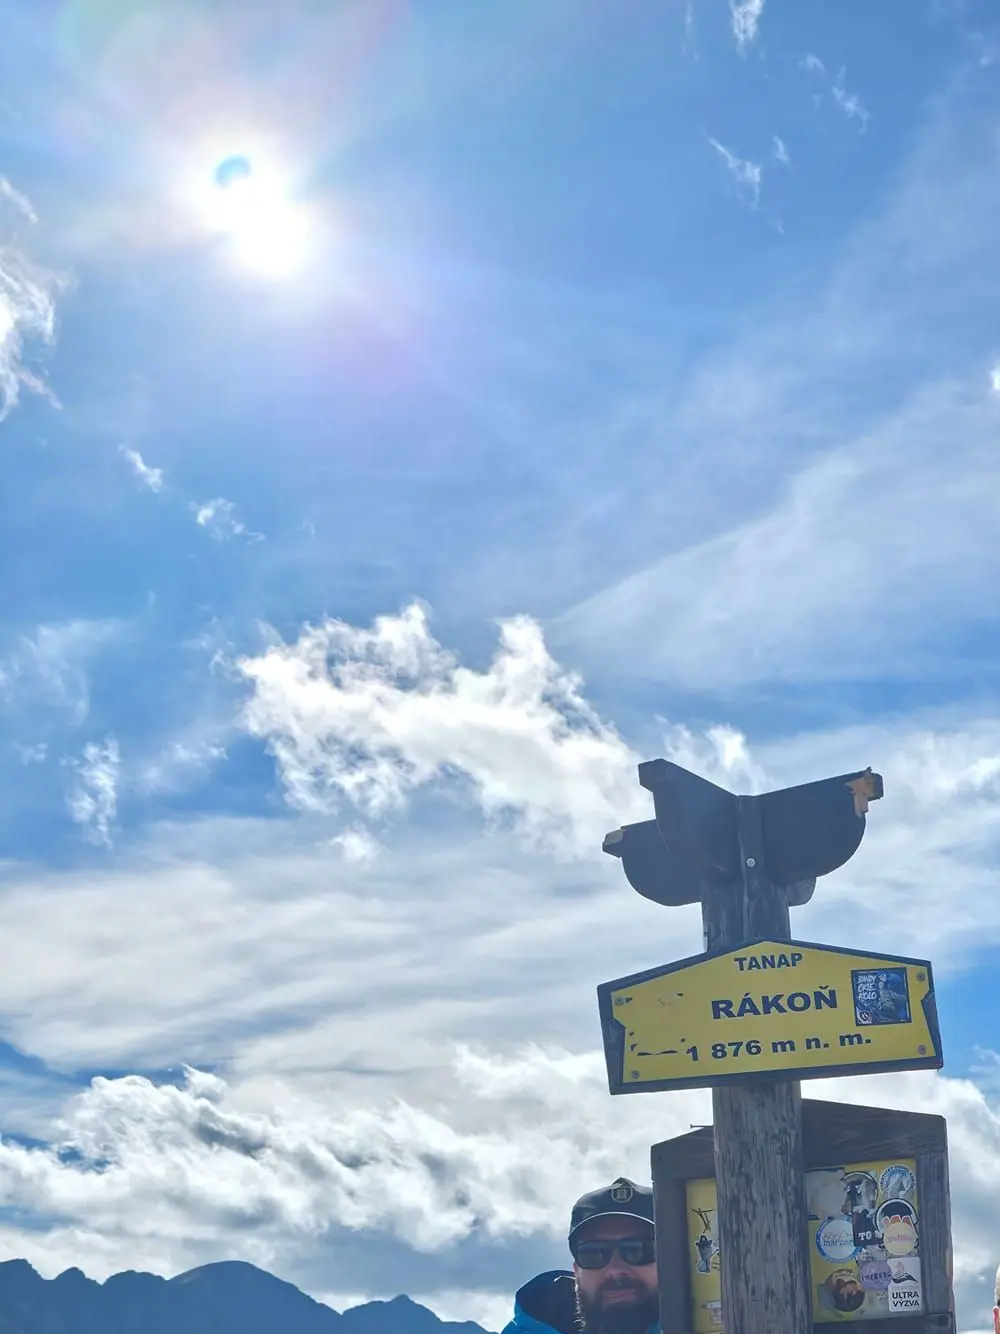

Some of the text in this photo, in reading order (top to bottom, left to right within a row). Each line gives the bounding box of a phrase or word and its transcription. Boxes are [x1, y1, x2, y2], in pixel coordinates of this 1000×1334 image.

[734, 952, 803, 971] TANAP
[711, 985, 839, 1020] RÁKOŇ
[686, 1032, 872, 1062] 1 876 m n. m.
[892, 1290, 920, 1299] ULTRA
[892, 1298, 920, 1308] VÝZVA
